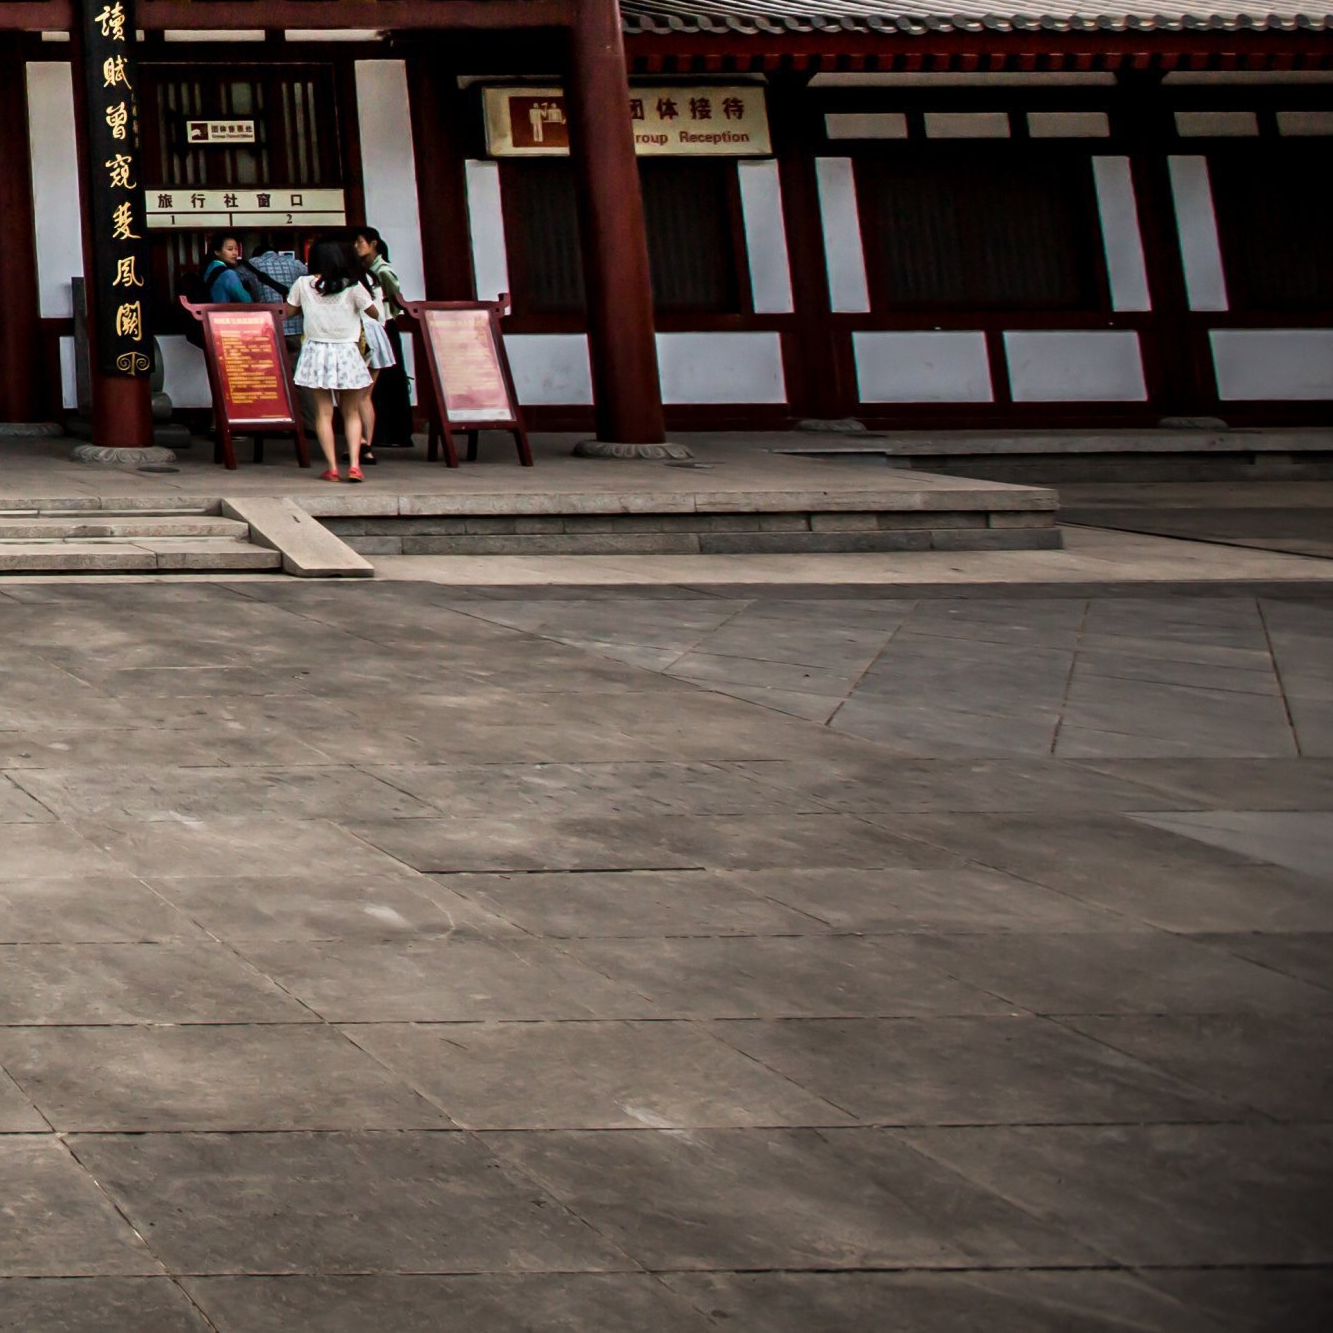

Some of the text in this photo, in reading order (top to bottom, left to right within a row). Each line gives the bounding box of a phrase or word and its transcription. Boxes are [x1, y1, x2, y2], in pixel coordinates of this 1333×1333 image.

[635, 131, 750, 146] roup Reception
[157, 193, 304, 209] 旅行社窗口
[170, 215, 176, 225] 1
[285, 214, 293, 225] 2
